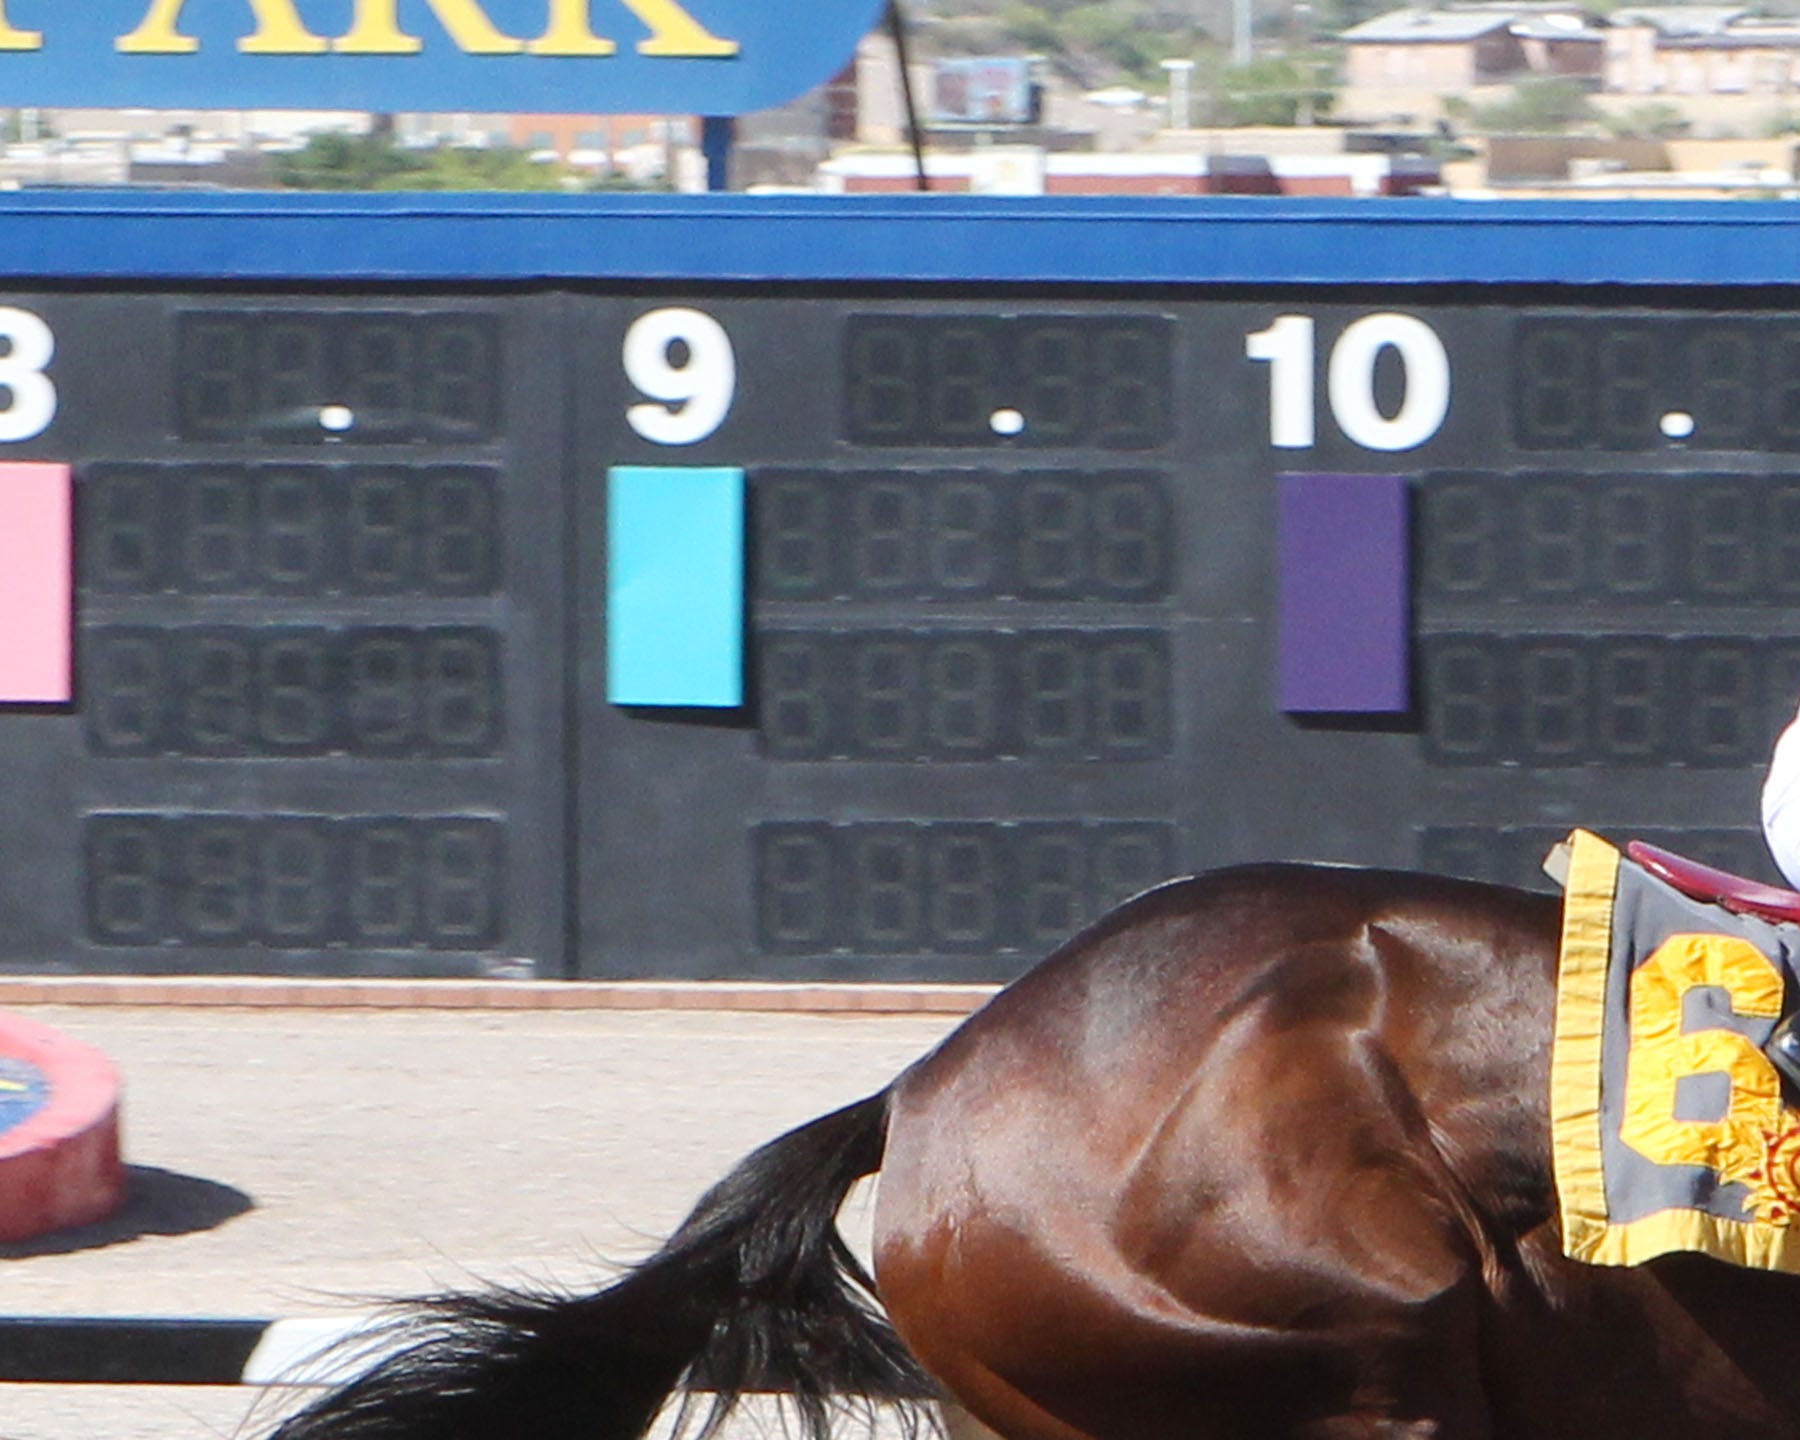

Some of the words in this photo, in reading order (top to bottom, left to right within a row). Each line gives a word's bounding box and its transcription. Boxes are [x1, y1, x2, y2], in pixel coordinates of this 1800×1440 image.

[622, 308, 736, 446] 9
[1246, 313, 1450, 451] 10
[1618, 932, 1785, 1167] 6
